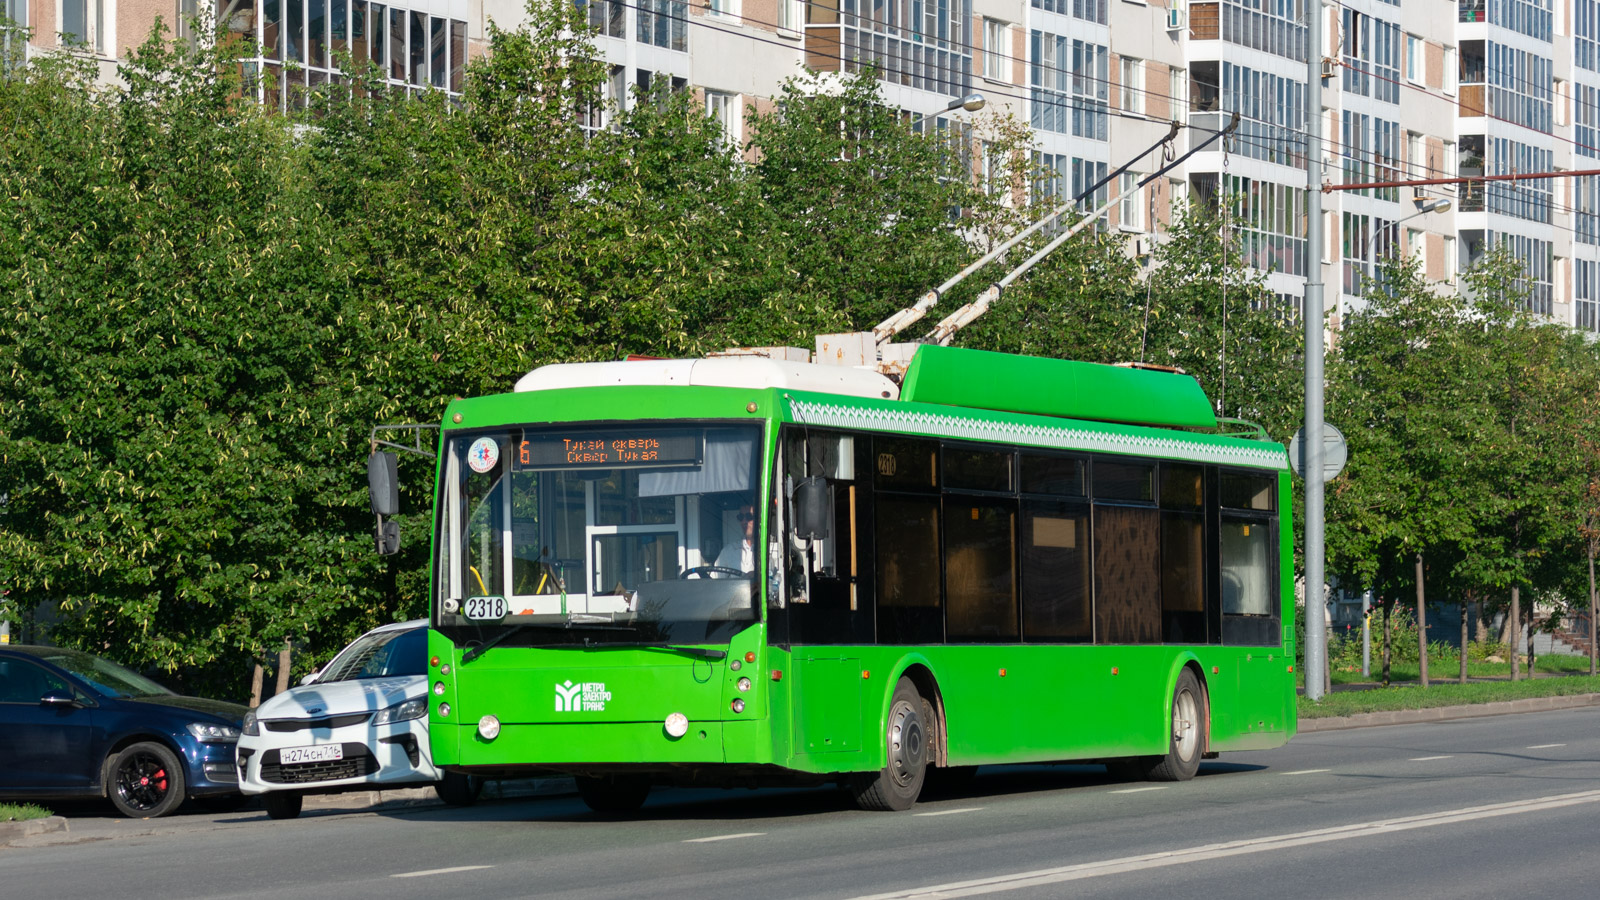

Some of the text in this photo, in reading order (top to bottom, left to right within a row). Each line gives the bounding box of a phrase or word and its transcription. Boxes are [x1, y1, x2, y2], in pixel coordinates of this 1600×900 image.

[520, 440, 530, 464] 6
[567, 449, 658, 464] Сквер Тукая
[880, 454, 895, 474] 2318
[469, 598, 503, 618] 2318
[582, 682, 605, 692] МЕТРО
[582, 691, 612, 701] ЭЛЕКТРО
[582, 701, 605, 711] ТРАНС
